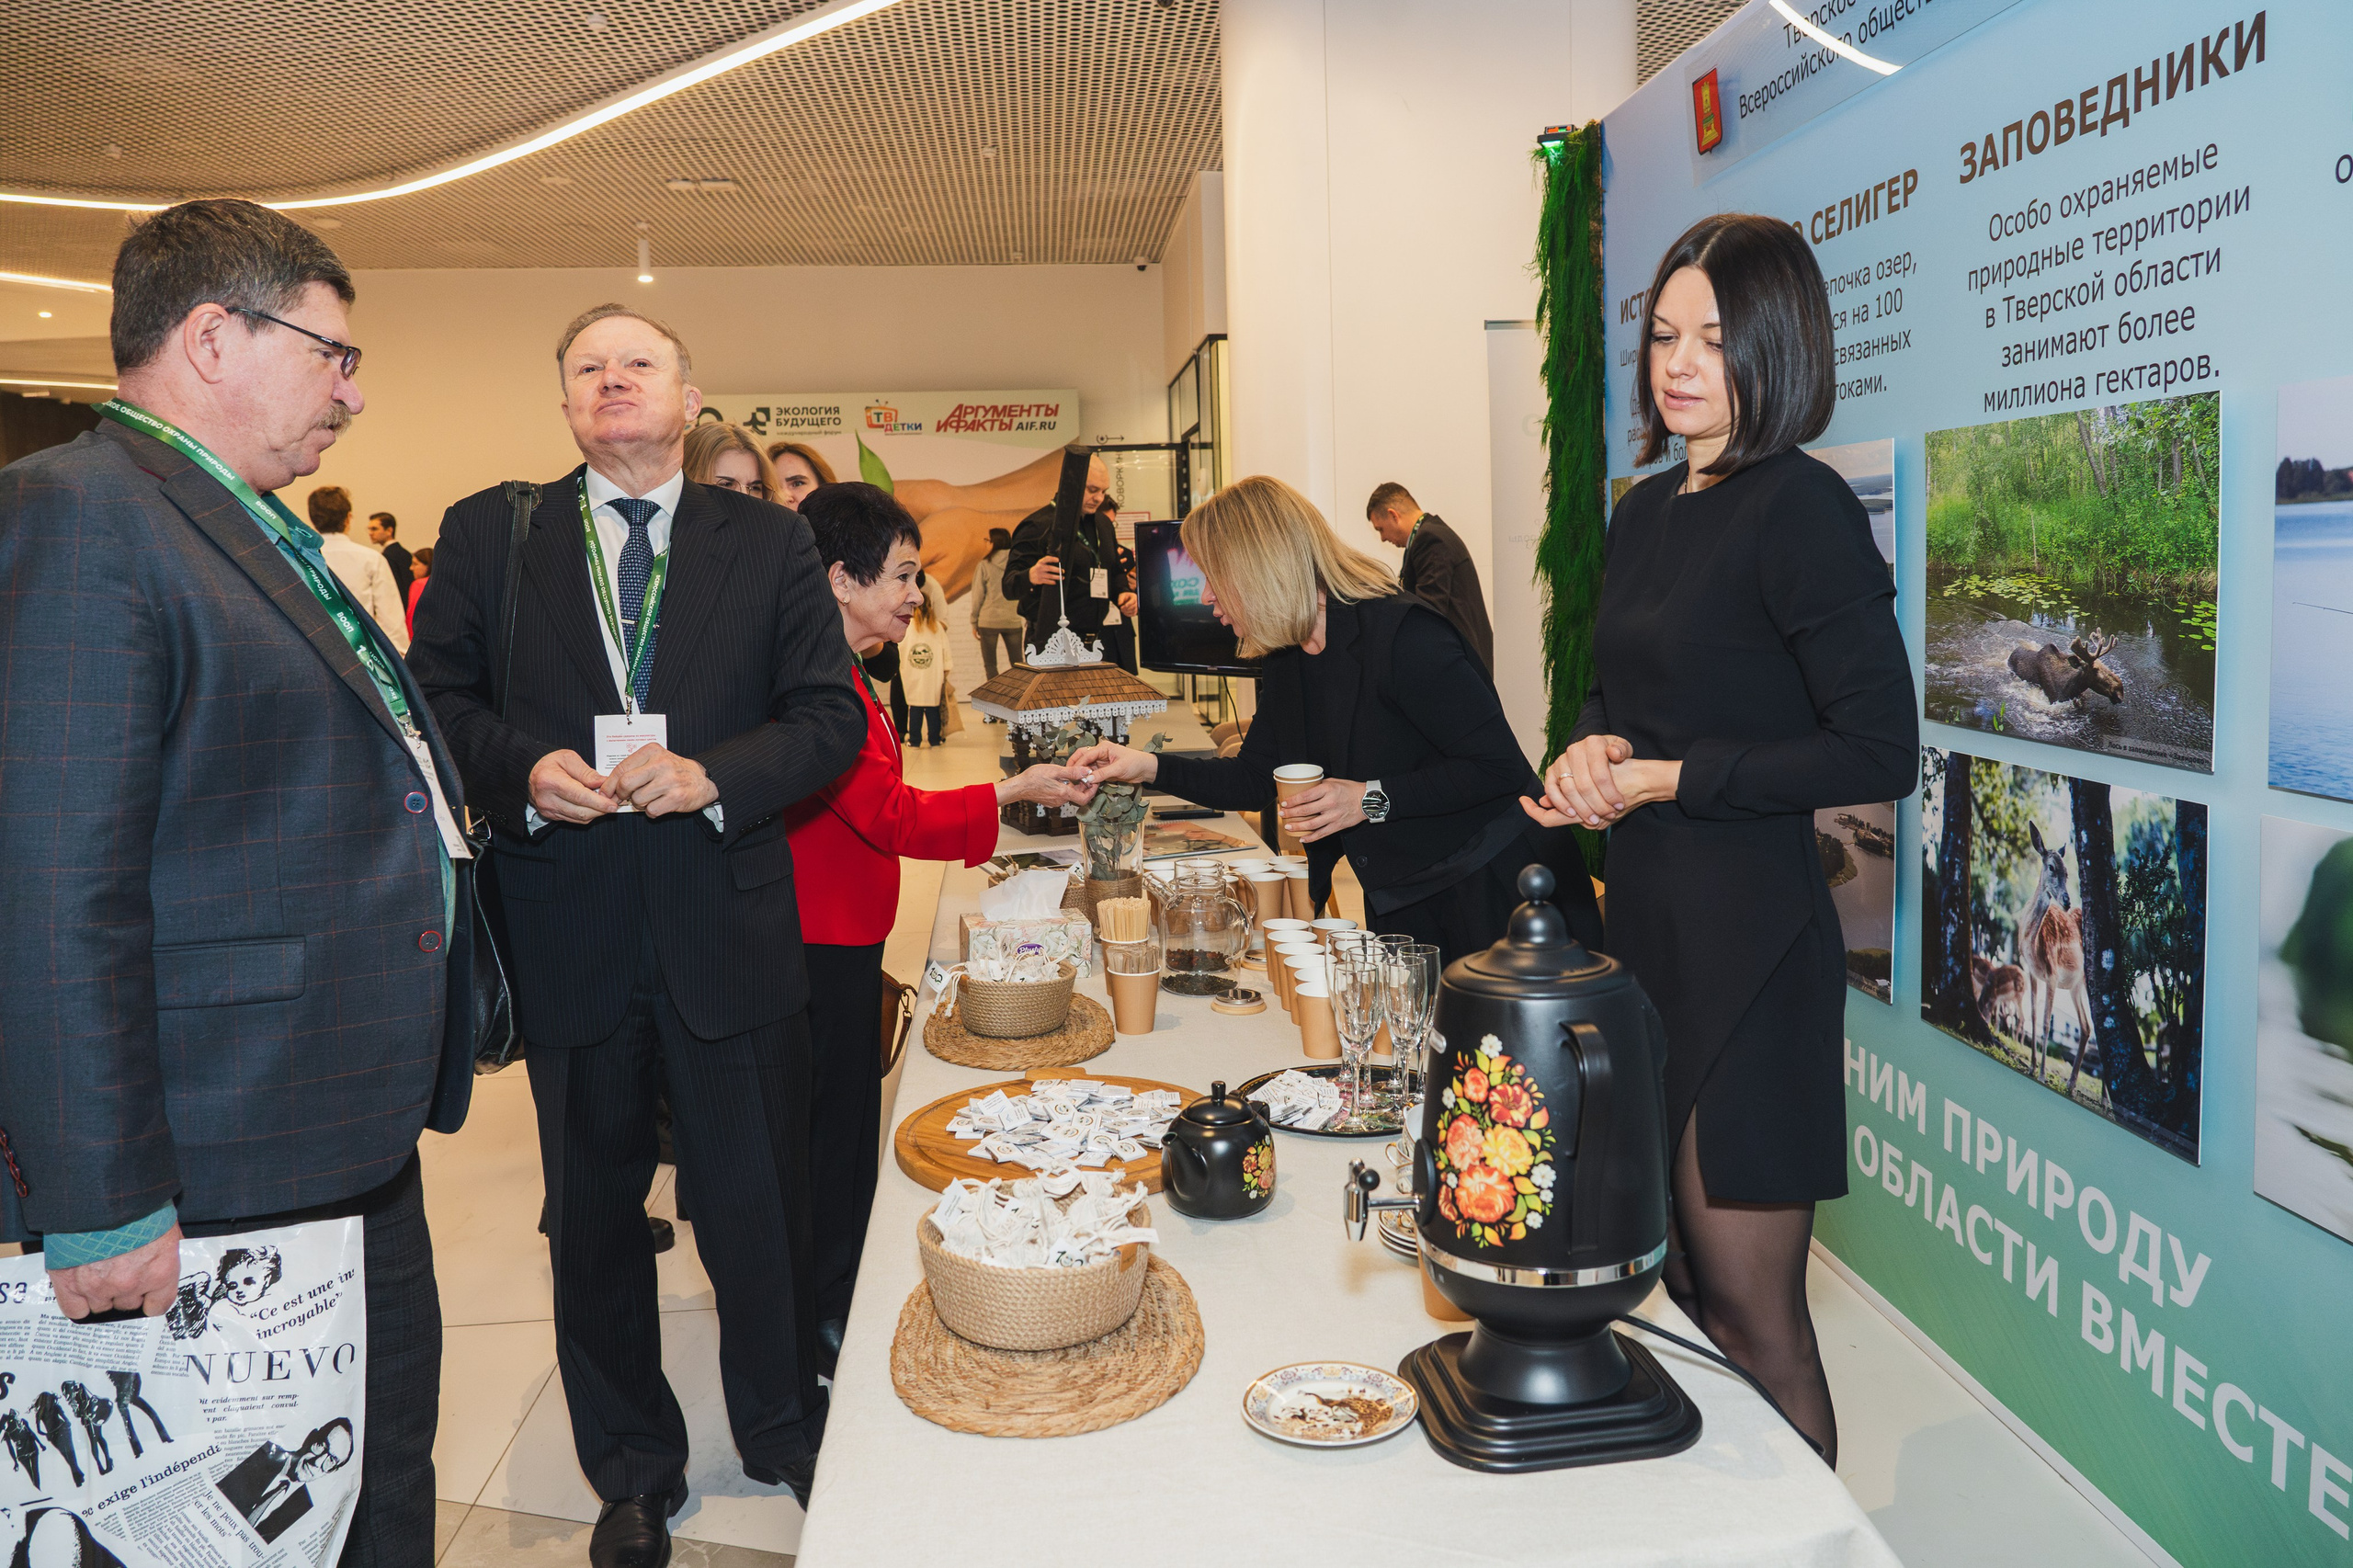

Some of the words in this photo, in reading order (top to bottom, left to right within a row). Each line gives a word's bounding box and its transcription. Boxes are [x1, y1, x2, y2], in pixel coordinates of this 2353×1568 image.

[1959, 9, 2267, 185] ЗАПОВЕДНИКИ
[1810, 168, 1918, 245] СЕЛИГЕР
[1988, 199, 2052, 242] Особо
[2060, 142, 2218, 218] охраняемые
[1968, 237, 2085, 294] природные
[2092, 186, 2250, 256] территории
[1876, 251, 1917, 281] озер,
[1852, 303, 1870, 326] на
[1875, 287, 1903, 319] 100
[1985, 306, 1995, 329] в
[2002, 270, 2105, 323] Тверской
[2114, 247, 2221, 297] области
[2001, 324, 2109, 368] занимают
[2118, 305, 2196, 345] более
[1984, 375, 2086, 414] миллиона
[2096, 354, 2221, 393] гектаров.
[776, 406, 840, 416] ЭКОЛОГИЯ
[776, 416, 842, 428] БУДУЩЕГО
[873, 412, 892, 423] ТВ
[884, 423, 922, 432] ДЕТКИ
[945, 403, 1060, 427] АРГУМЕНТЫ
[1015, 421, 1057, 431] AIF.RU
[120, 405, 164, 430] ОБЩЕСТВО
[162, 426, 198, 450] ОХРАНЫ
[196, 448, 235, 481] ПРИРОДЫ
[335, 610, 355, 633] ВООП
[1944, 1097, 2211, 1309] ПРИРОДУ
[283, 1294, 304, 1312] est
[306, 1279, 334, 1300] une
[1854, 1125, 2059, 1318] ОБЛАСТИ
[2081, 1280, 2352, 1541] ВМЕСТЕ
[183, 1343, 355, 1386] NUEVO
[97, 1485, 138, 1511] exige
[202, 1507, 212, 1520] les
[211, 1501, 222, 1512] ne
[220, 1511, 240, 1530] peux
[235, 1528, 248, 1543] pas
